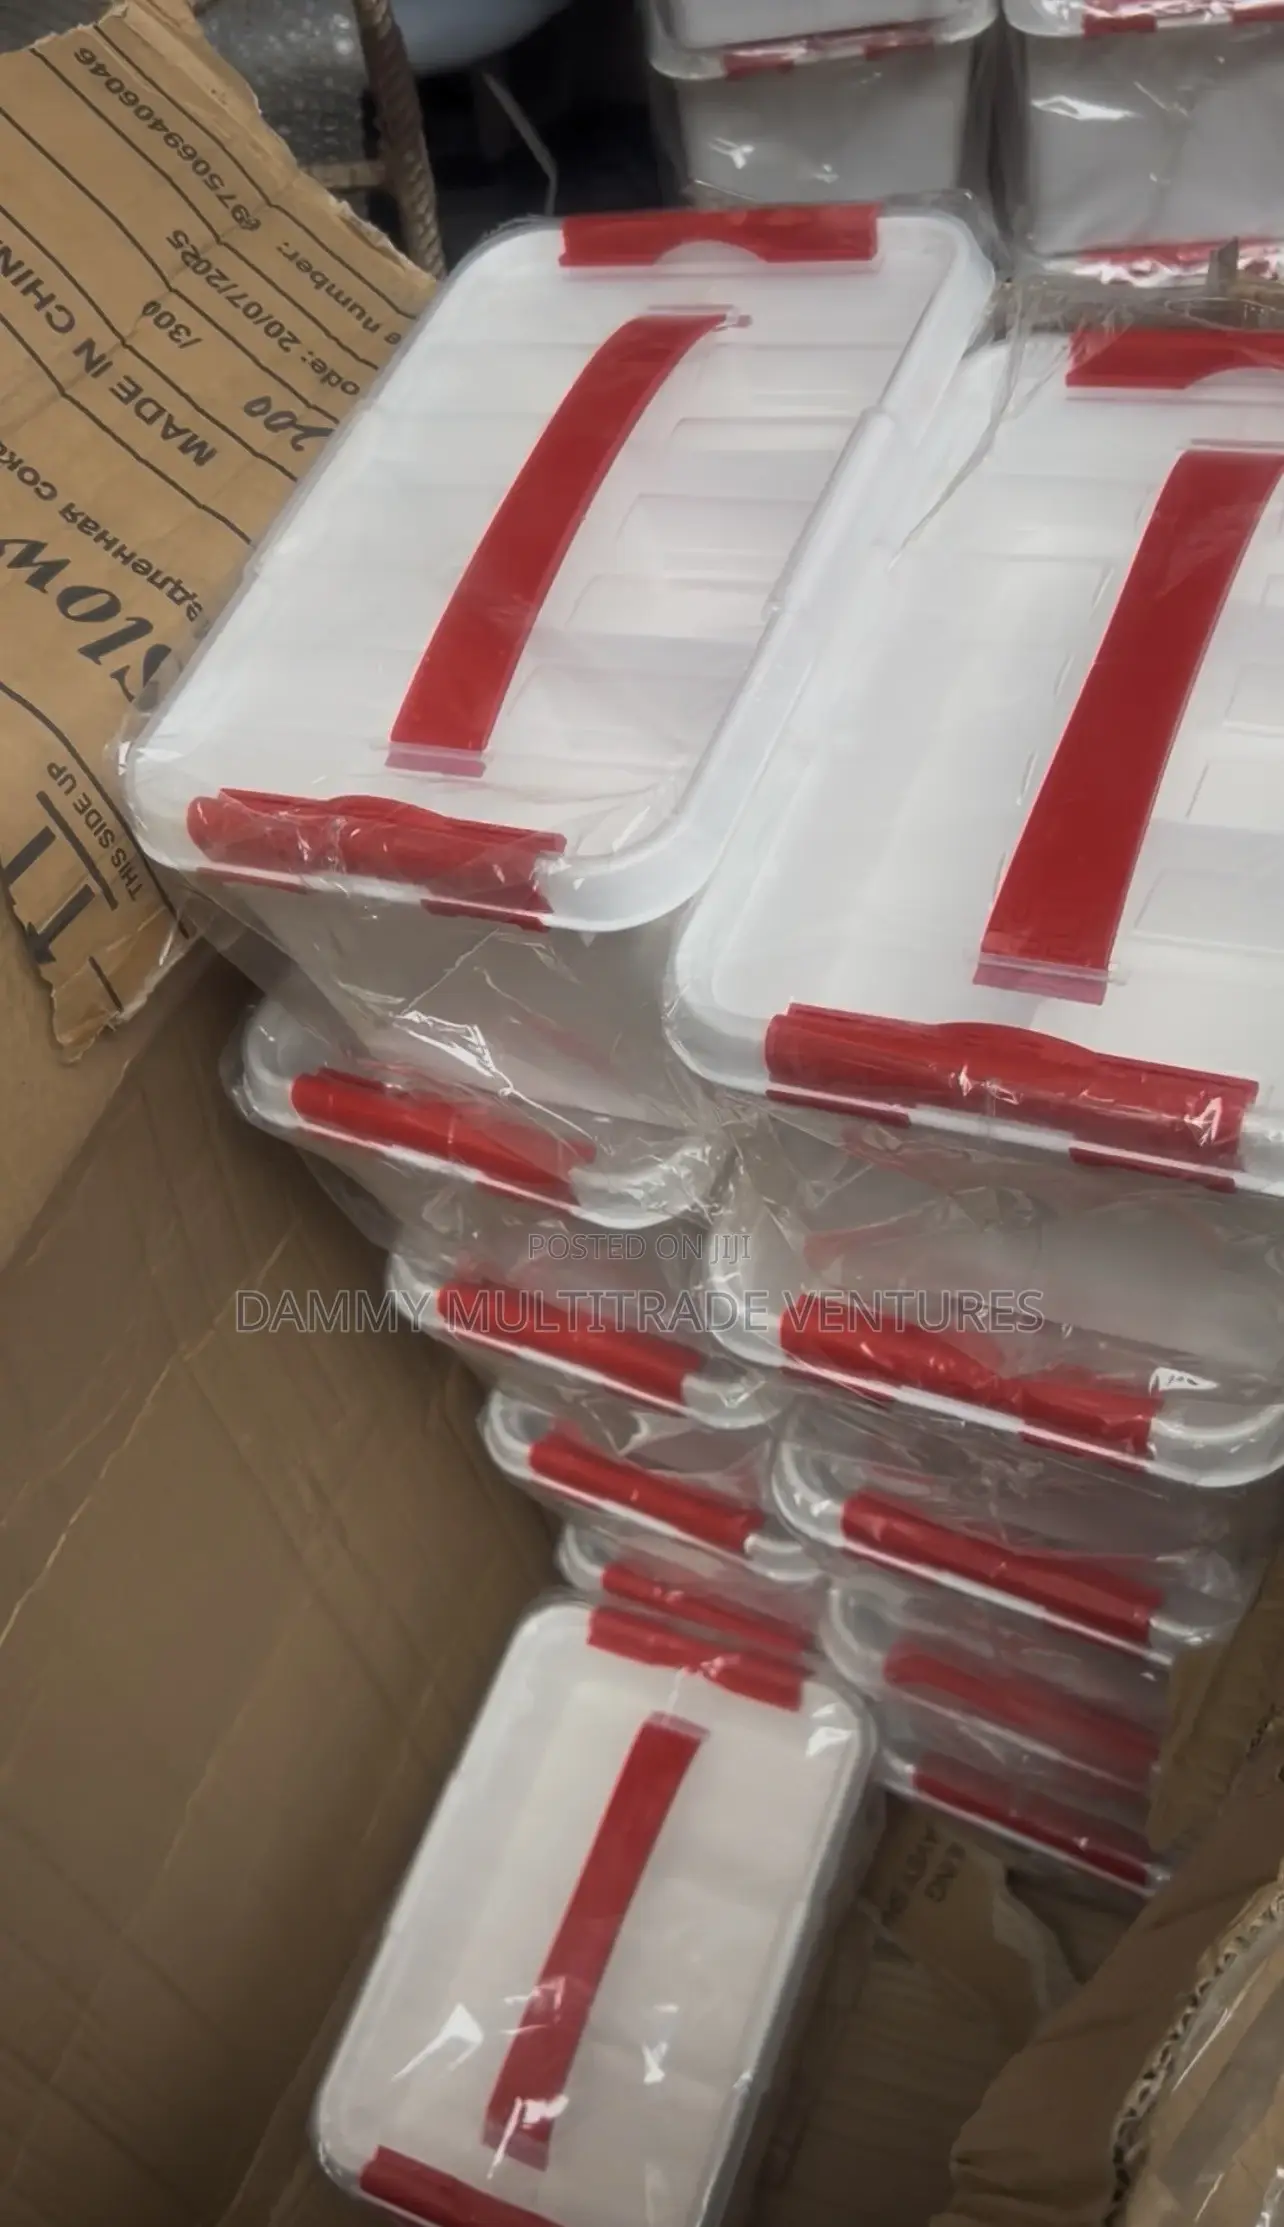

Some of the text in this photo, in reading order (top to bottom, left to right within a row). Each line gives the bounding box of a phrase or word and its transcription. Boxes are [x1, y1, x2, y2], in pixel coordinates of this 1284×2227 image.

[141, 300, 202, 349] /300
[165, 229, 301, 353] 20/07/2025
[276, 241, 381, 334] number:
[0, 240, 217, 467] MADE IN CHIN
[243, 396, 337, 452] 200
[46, 762, 144, 902] THIS SIDE UP
